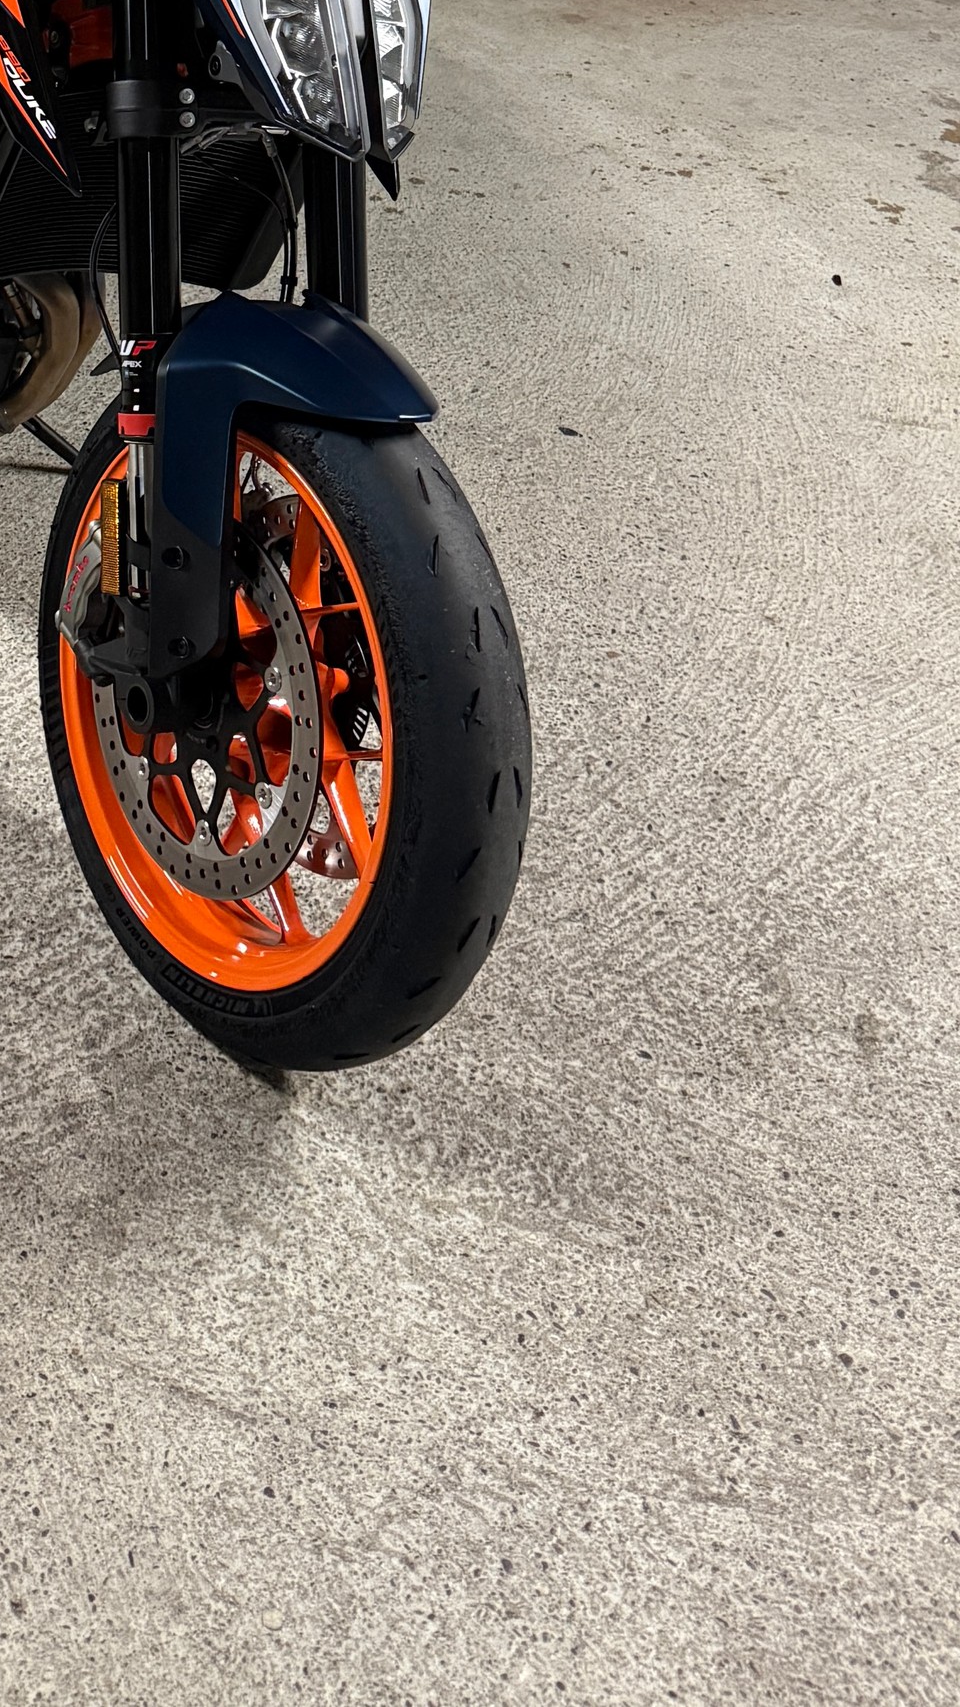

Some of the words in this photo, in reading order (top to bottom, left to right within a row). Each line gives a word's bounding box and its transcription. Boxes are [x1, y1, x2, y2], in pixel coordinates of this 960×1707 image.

[3, 57, 57, 140] DUKE
[114, 906, 157, 960] POWER
[163, 965, 248, 1014] MICHELIN
